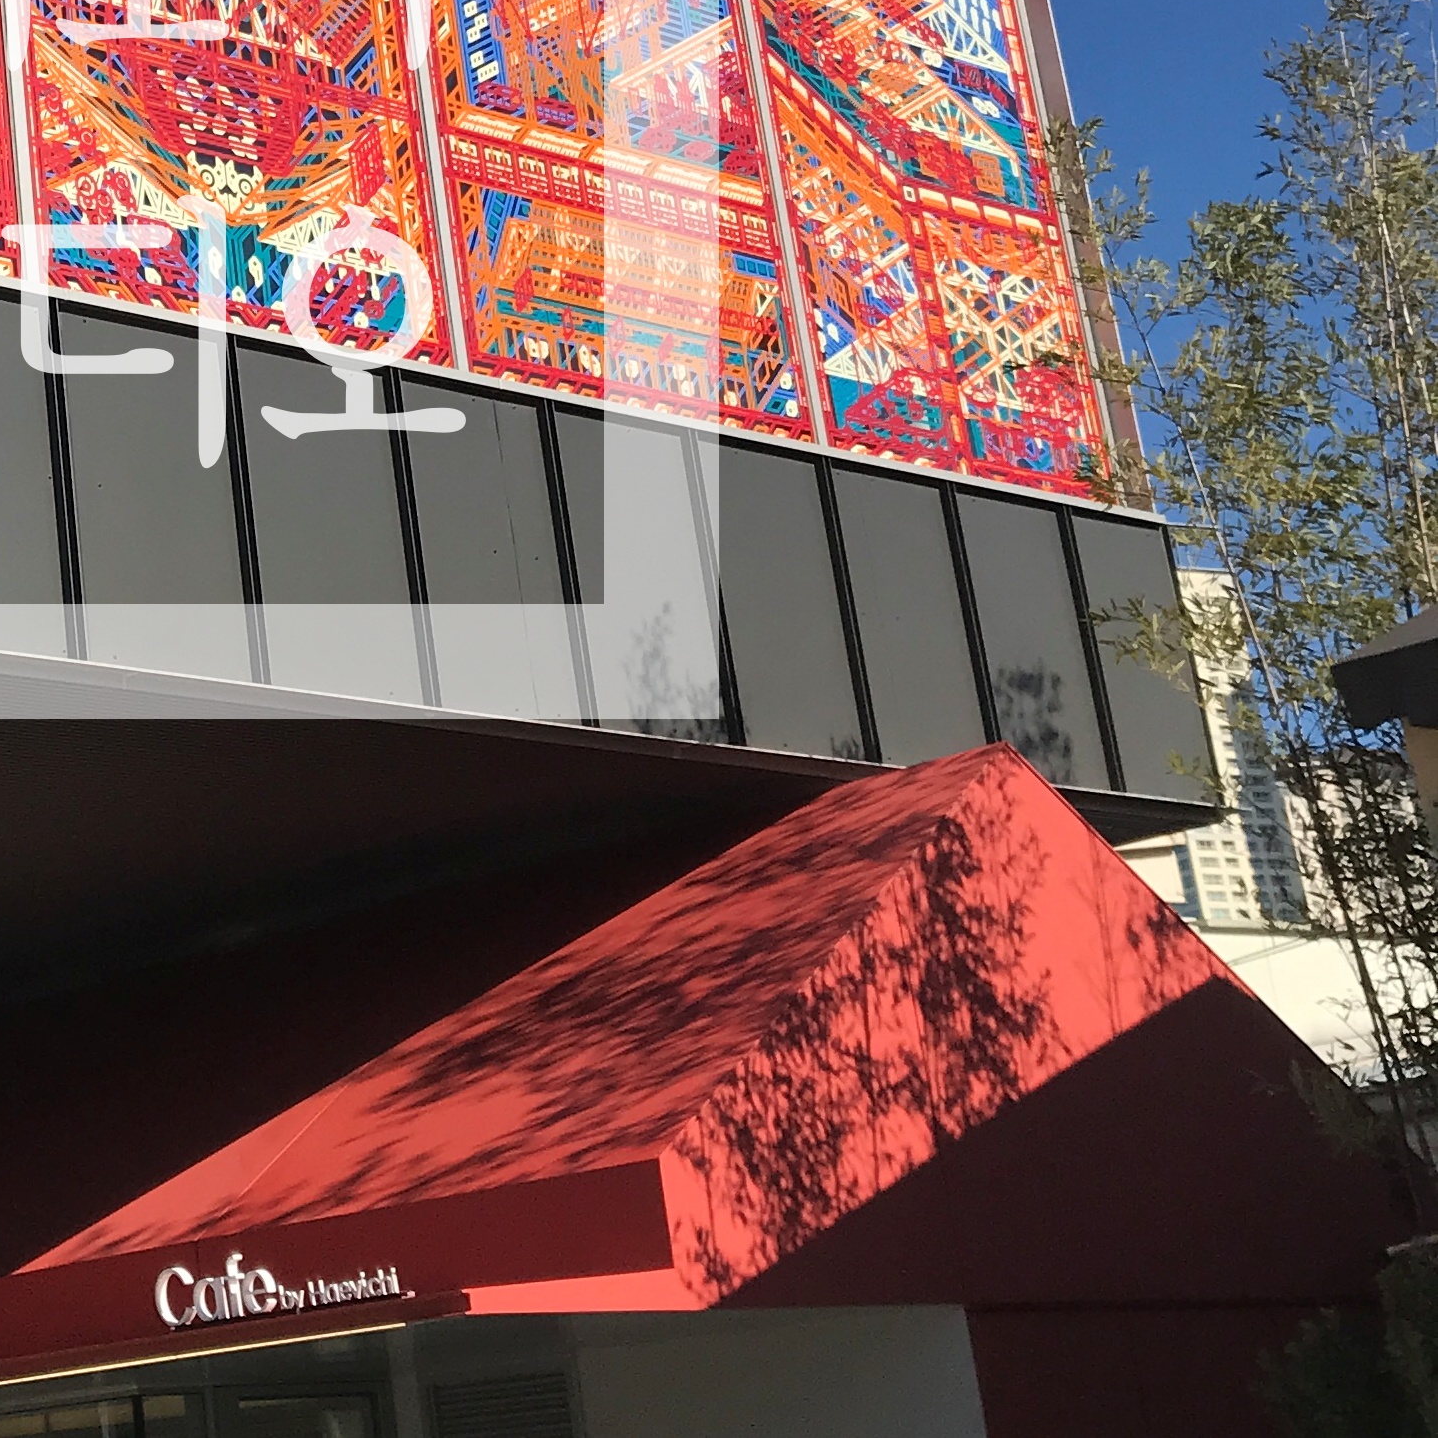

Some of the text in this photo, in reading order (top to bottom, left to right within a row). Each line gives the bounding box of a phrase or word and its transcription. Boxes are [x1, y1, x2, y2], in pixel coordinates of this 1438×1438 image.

[155, 1253, 400, 1326] Cafe by Haevichi
